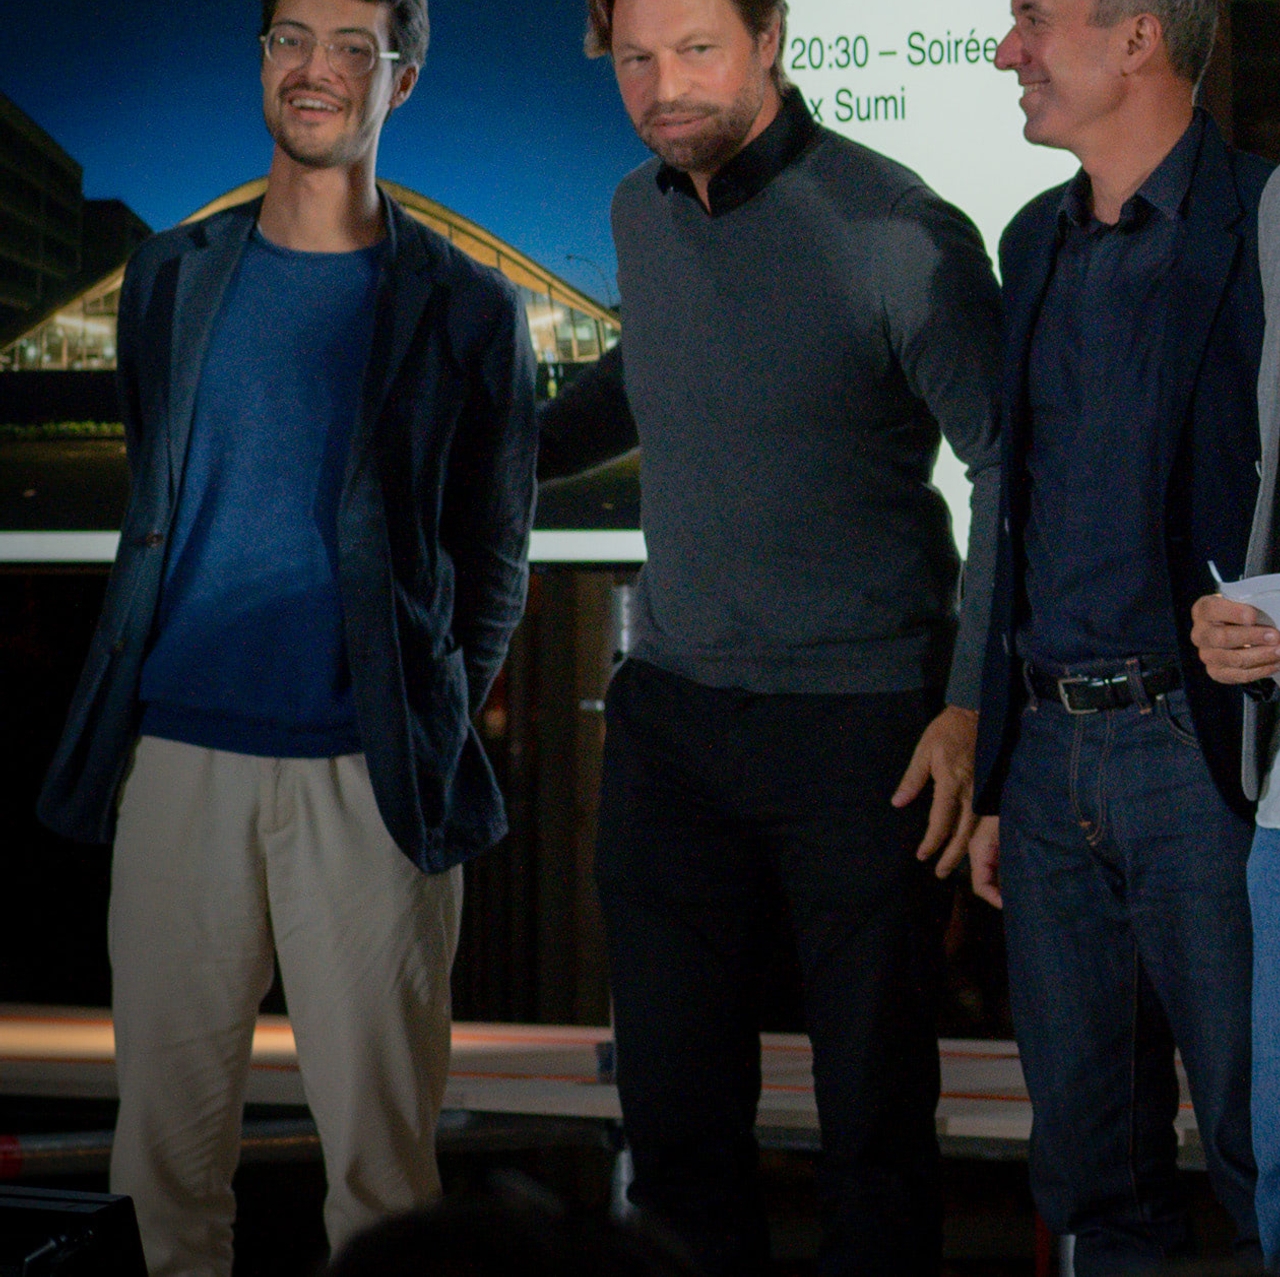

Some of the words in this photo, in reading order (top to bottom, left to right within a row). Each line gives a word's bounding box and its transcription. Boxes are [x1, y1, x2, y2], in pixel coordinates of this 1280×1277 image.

[789, 34, 870, 71] 20:30
[906, 27, 997, 67] Soirée
[833, 85, 906, 124] Sumi
